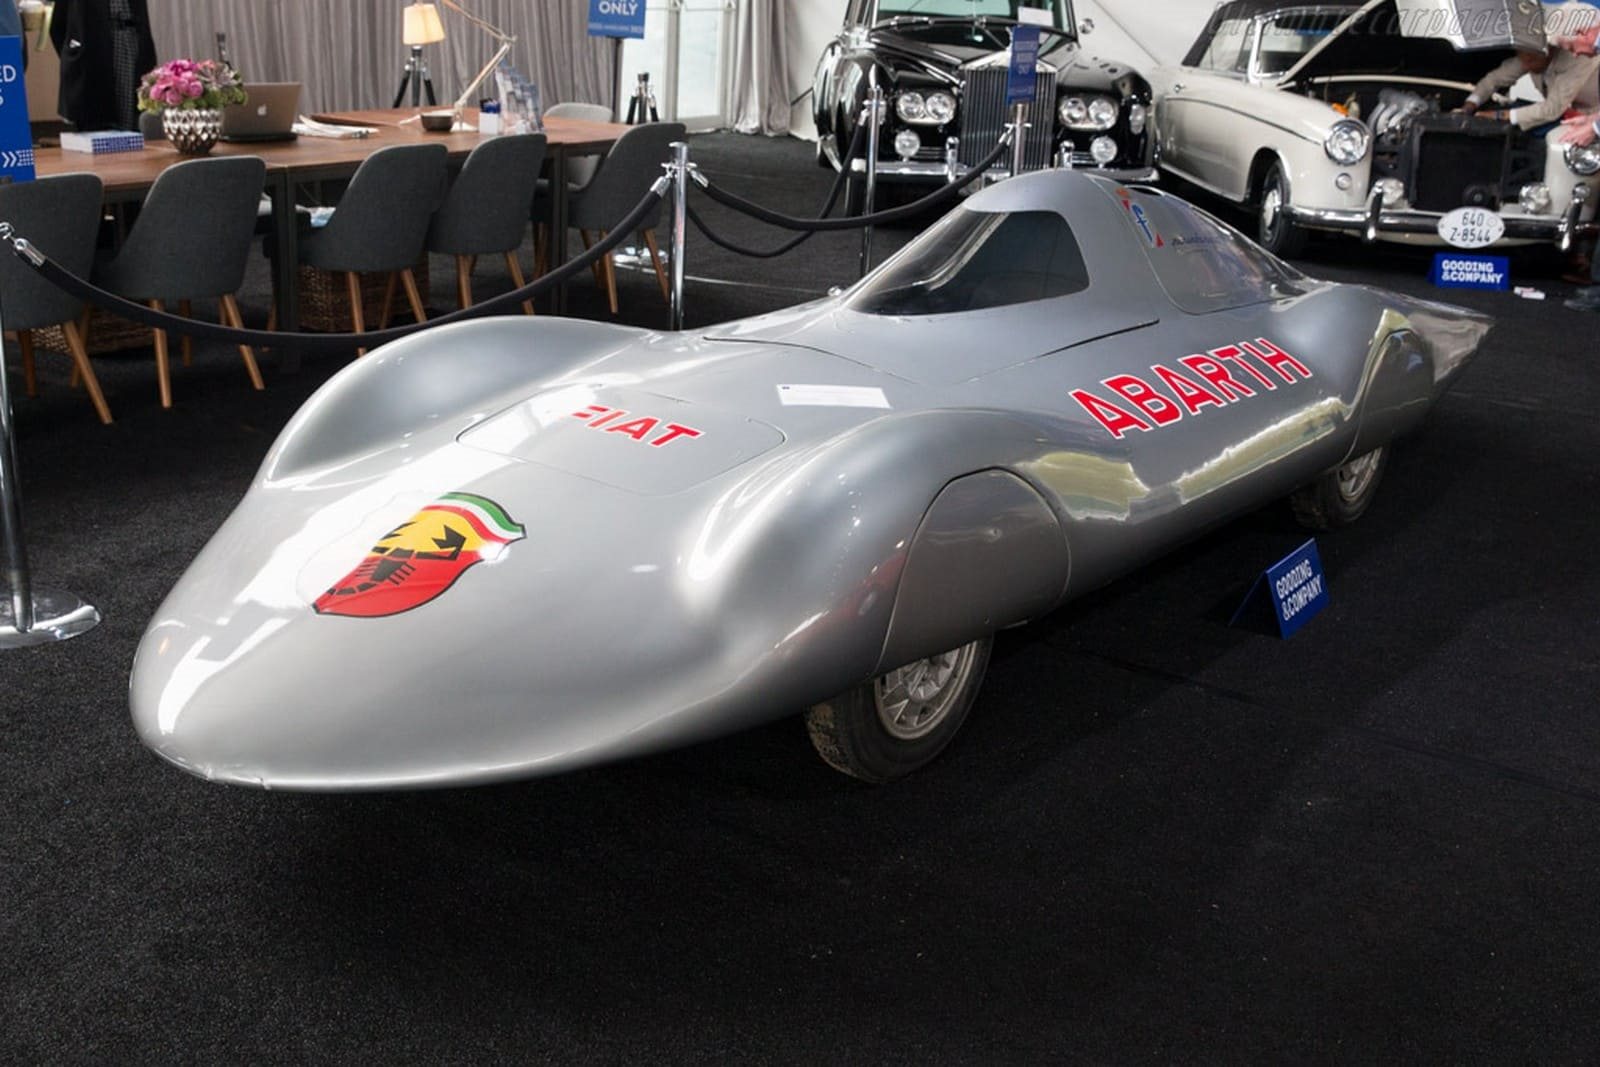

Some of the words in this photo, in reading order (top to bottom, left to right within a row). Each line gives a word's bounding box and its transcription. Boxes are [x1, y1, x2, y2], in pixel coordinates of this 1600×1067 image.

[599, 1, 638, 16] ONLY
[0, 64, 17, 82] D
[1462, 210, 1485, 227] 640
[1449, 227, 1491, 243] Z-8544
[1442, 260, 1494, 273] GOODING
[1441, 271, 1504, 284] &COMPANY
[1068, 337, 1313, 440] ABARTH
[571, 404, 706, 447] FIAT
[1276, 559, 1313, 600] GOODING
[1281, 574, 1322, 621] &COMPANY
